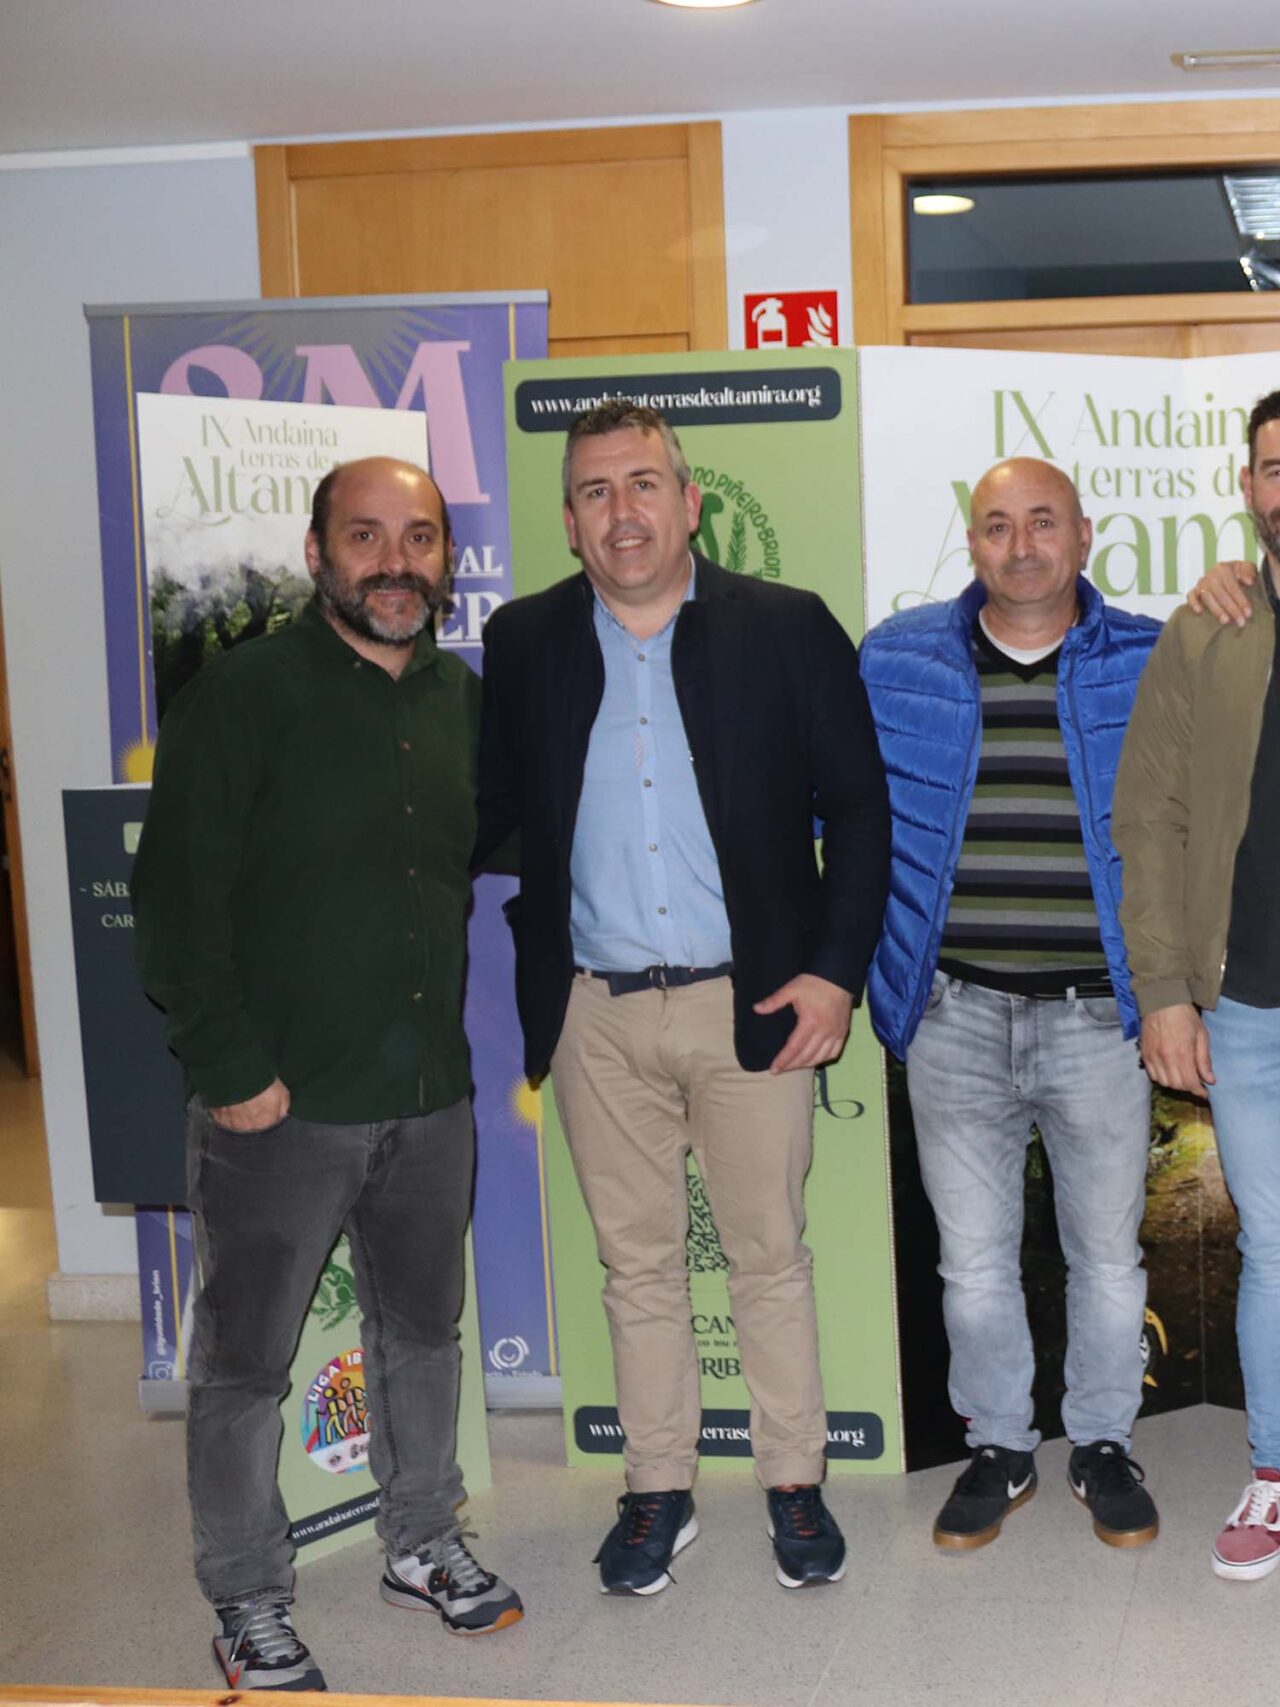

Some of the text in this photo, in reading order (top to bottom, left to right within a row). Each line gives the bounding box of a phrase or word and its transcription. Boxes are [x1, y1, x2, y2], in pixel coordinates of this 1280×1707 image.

[531, 385, 821, 413] www.anaterrasdealtamira.org
[202, 414, 338, 448] IX Andaina
[992, 390, 1250, 459] IX Andain
[239, 449, 329, 470] terras de
[1072, 459, 1196, 499] terras
[450, 545, 503, 573] AL
[92, 878, 130, 898] SÁB
[308, 1364, 341, 1402] LIGA
